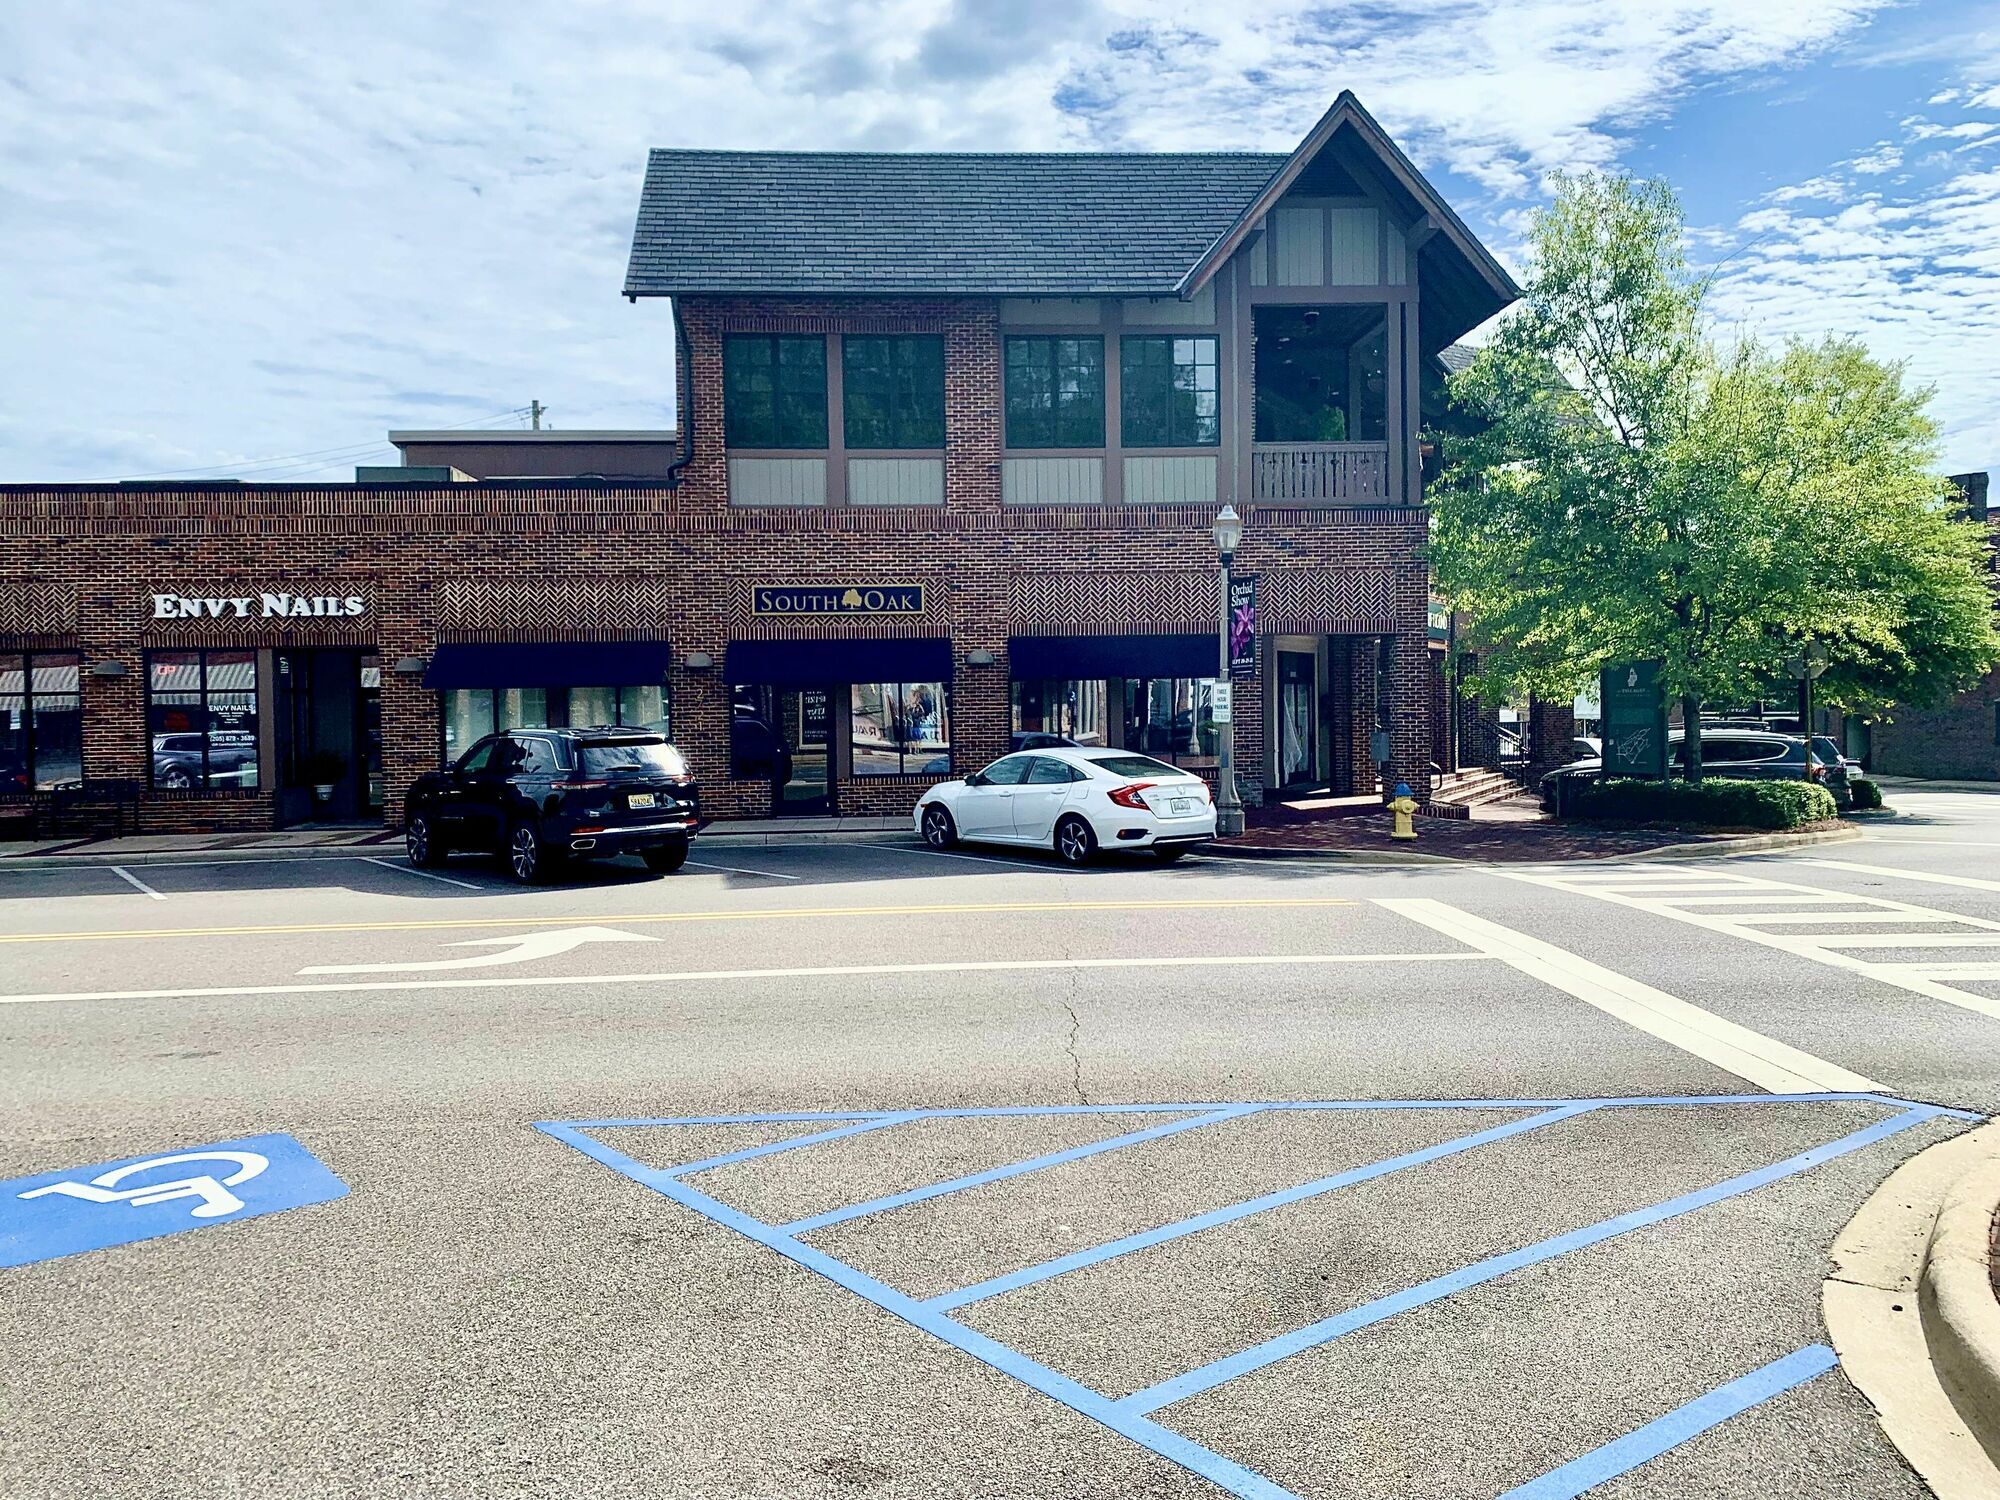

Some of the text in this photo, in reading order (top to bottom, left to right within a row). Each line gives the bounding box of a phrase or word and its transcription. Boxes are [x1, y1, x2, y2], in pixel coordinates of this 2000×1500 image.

[1231, 581, 1253, 595] Orchid
[152, 593, 365, 618] ENVY NAILS
[761, 590, 915, 611] SOUTH OAK
[1231, 594, 1250, 607] Show
[208, 704, 254, 712] ENVY NAILS
